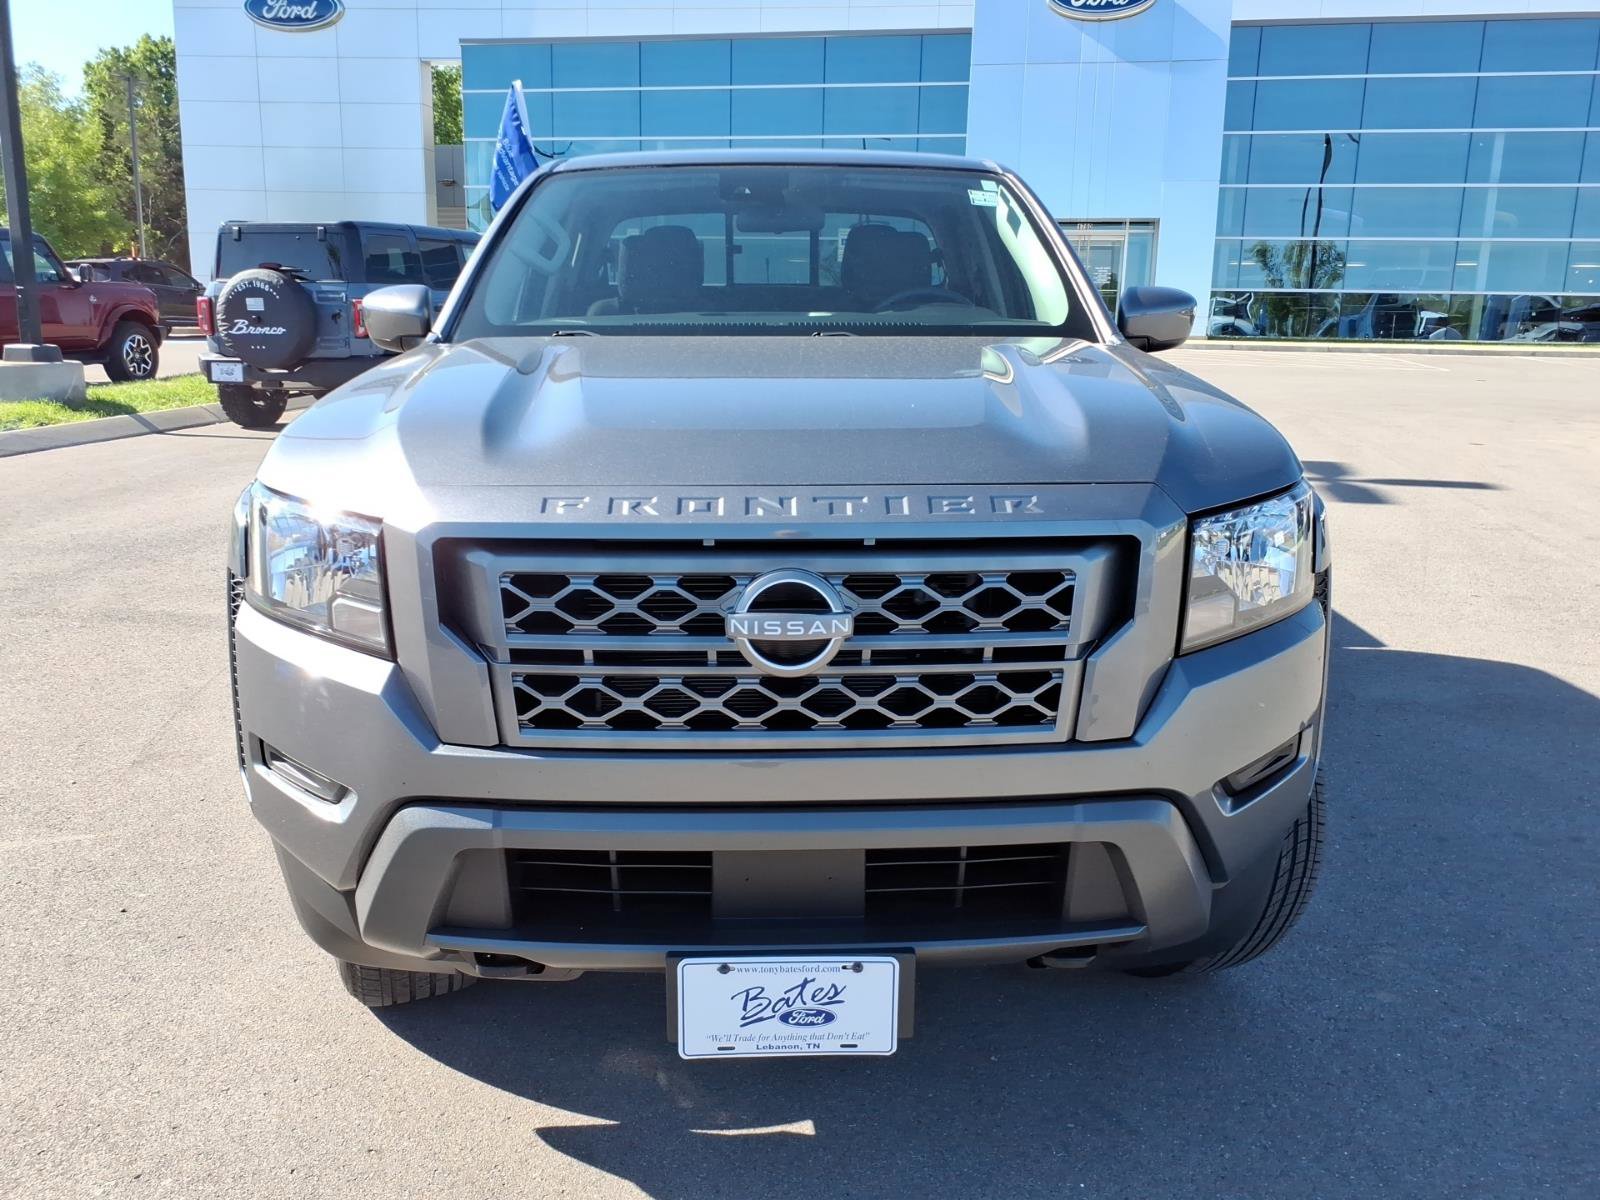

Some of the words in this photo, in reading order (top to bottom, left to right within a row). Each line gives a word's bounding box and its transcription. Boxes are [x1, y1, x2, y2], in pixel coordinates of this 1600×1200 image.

[262, 0, 318, 19] Ford
[236, 281, 252, 292] EST.
[228, 319, 287, 335] Bronco
[540, 494, 1044, 517] FRONTIER
[730, 617, 850, 636] NISSAN
[737, 964, 841, 975] www.tonybatesford.com
[731, 977, 847, 1021] Bates
[788, 1009, 826, 1025] Ford
[733, 1032, 755, 1042] Trade
[757, 1032, 770, 1043] for
[772, 1032, 807, 1043] Anything
[809, 1032, 825, 1041] that
[756, 1043, 803, 1051] Lebanon,
[806, 1042, 821, 1050] TN
